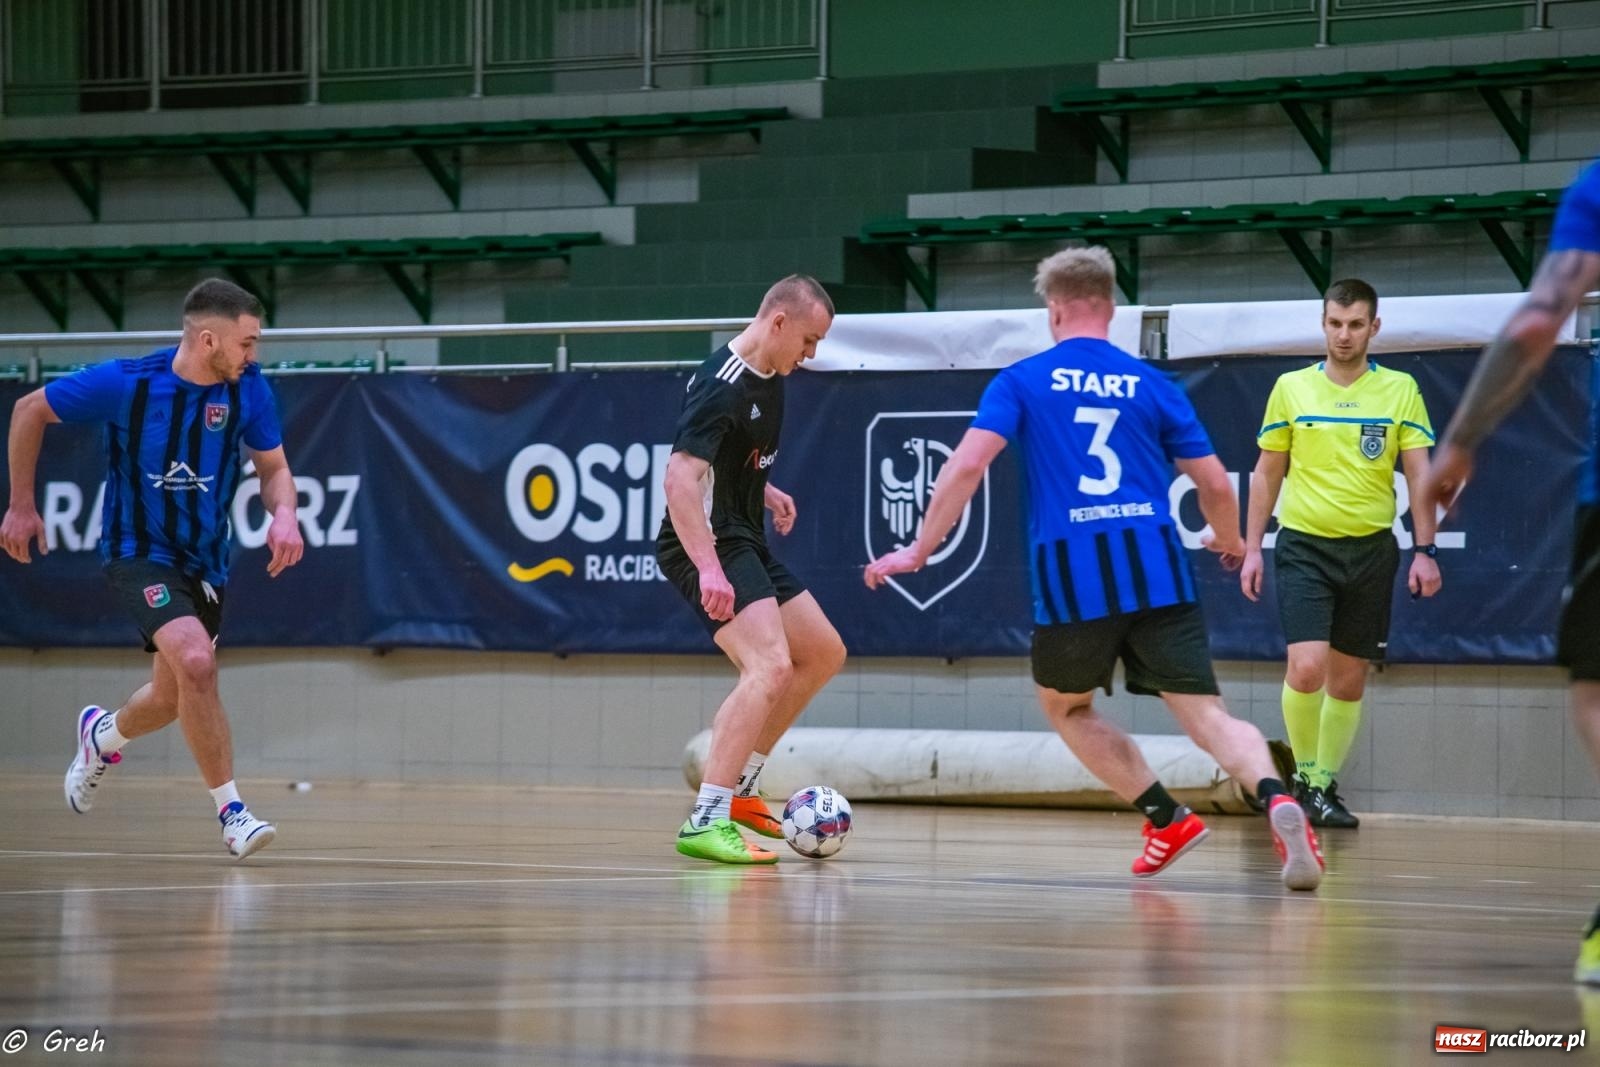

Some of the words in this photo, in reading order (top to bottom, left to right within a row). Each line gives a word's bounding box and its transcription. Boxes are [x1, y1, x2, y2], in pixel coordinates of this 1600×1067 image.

[1051, 367, 1140, 398] START
[1073, 406, 1122, 496] 3
[585, 554, 668, 581] RACIB
